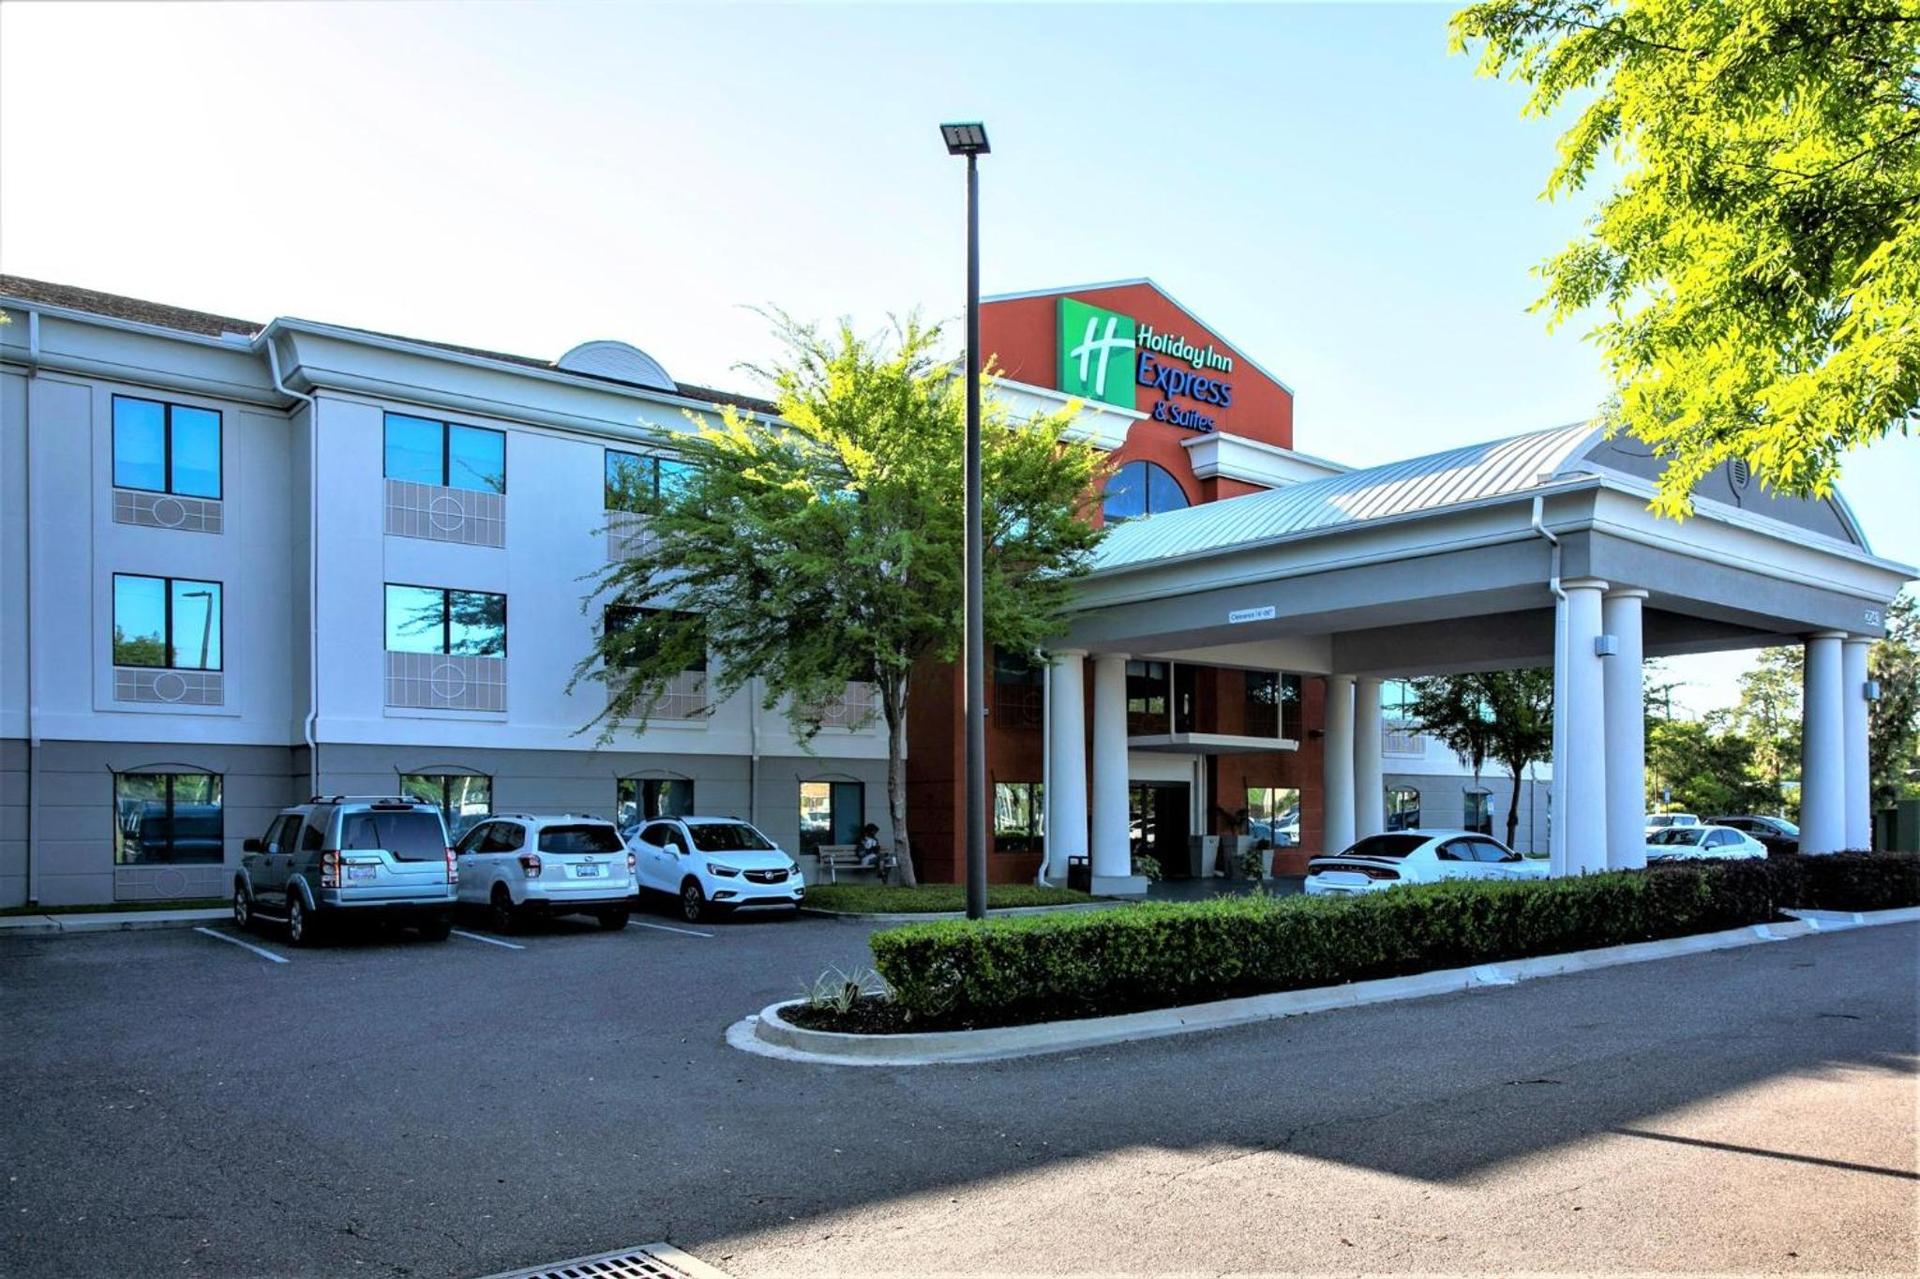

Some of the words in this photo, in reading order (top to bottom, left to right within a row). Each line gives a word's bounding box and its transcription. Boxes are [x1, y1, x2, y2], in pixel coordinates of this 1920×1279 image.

[1137, 323, 1205, 369] Holiday
[1206, 344, 1233, 373] Inn
[1137, 351, 1233, 408] Express
[1154, 400, 1169, 420] &
[1169, 404, 1216, 432] Suites
